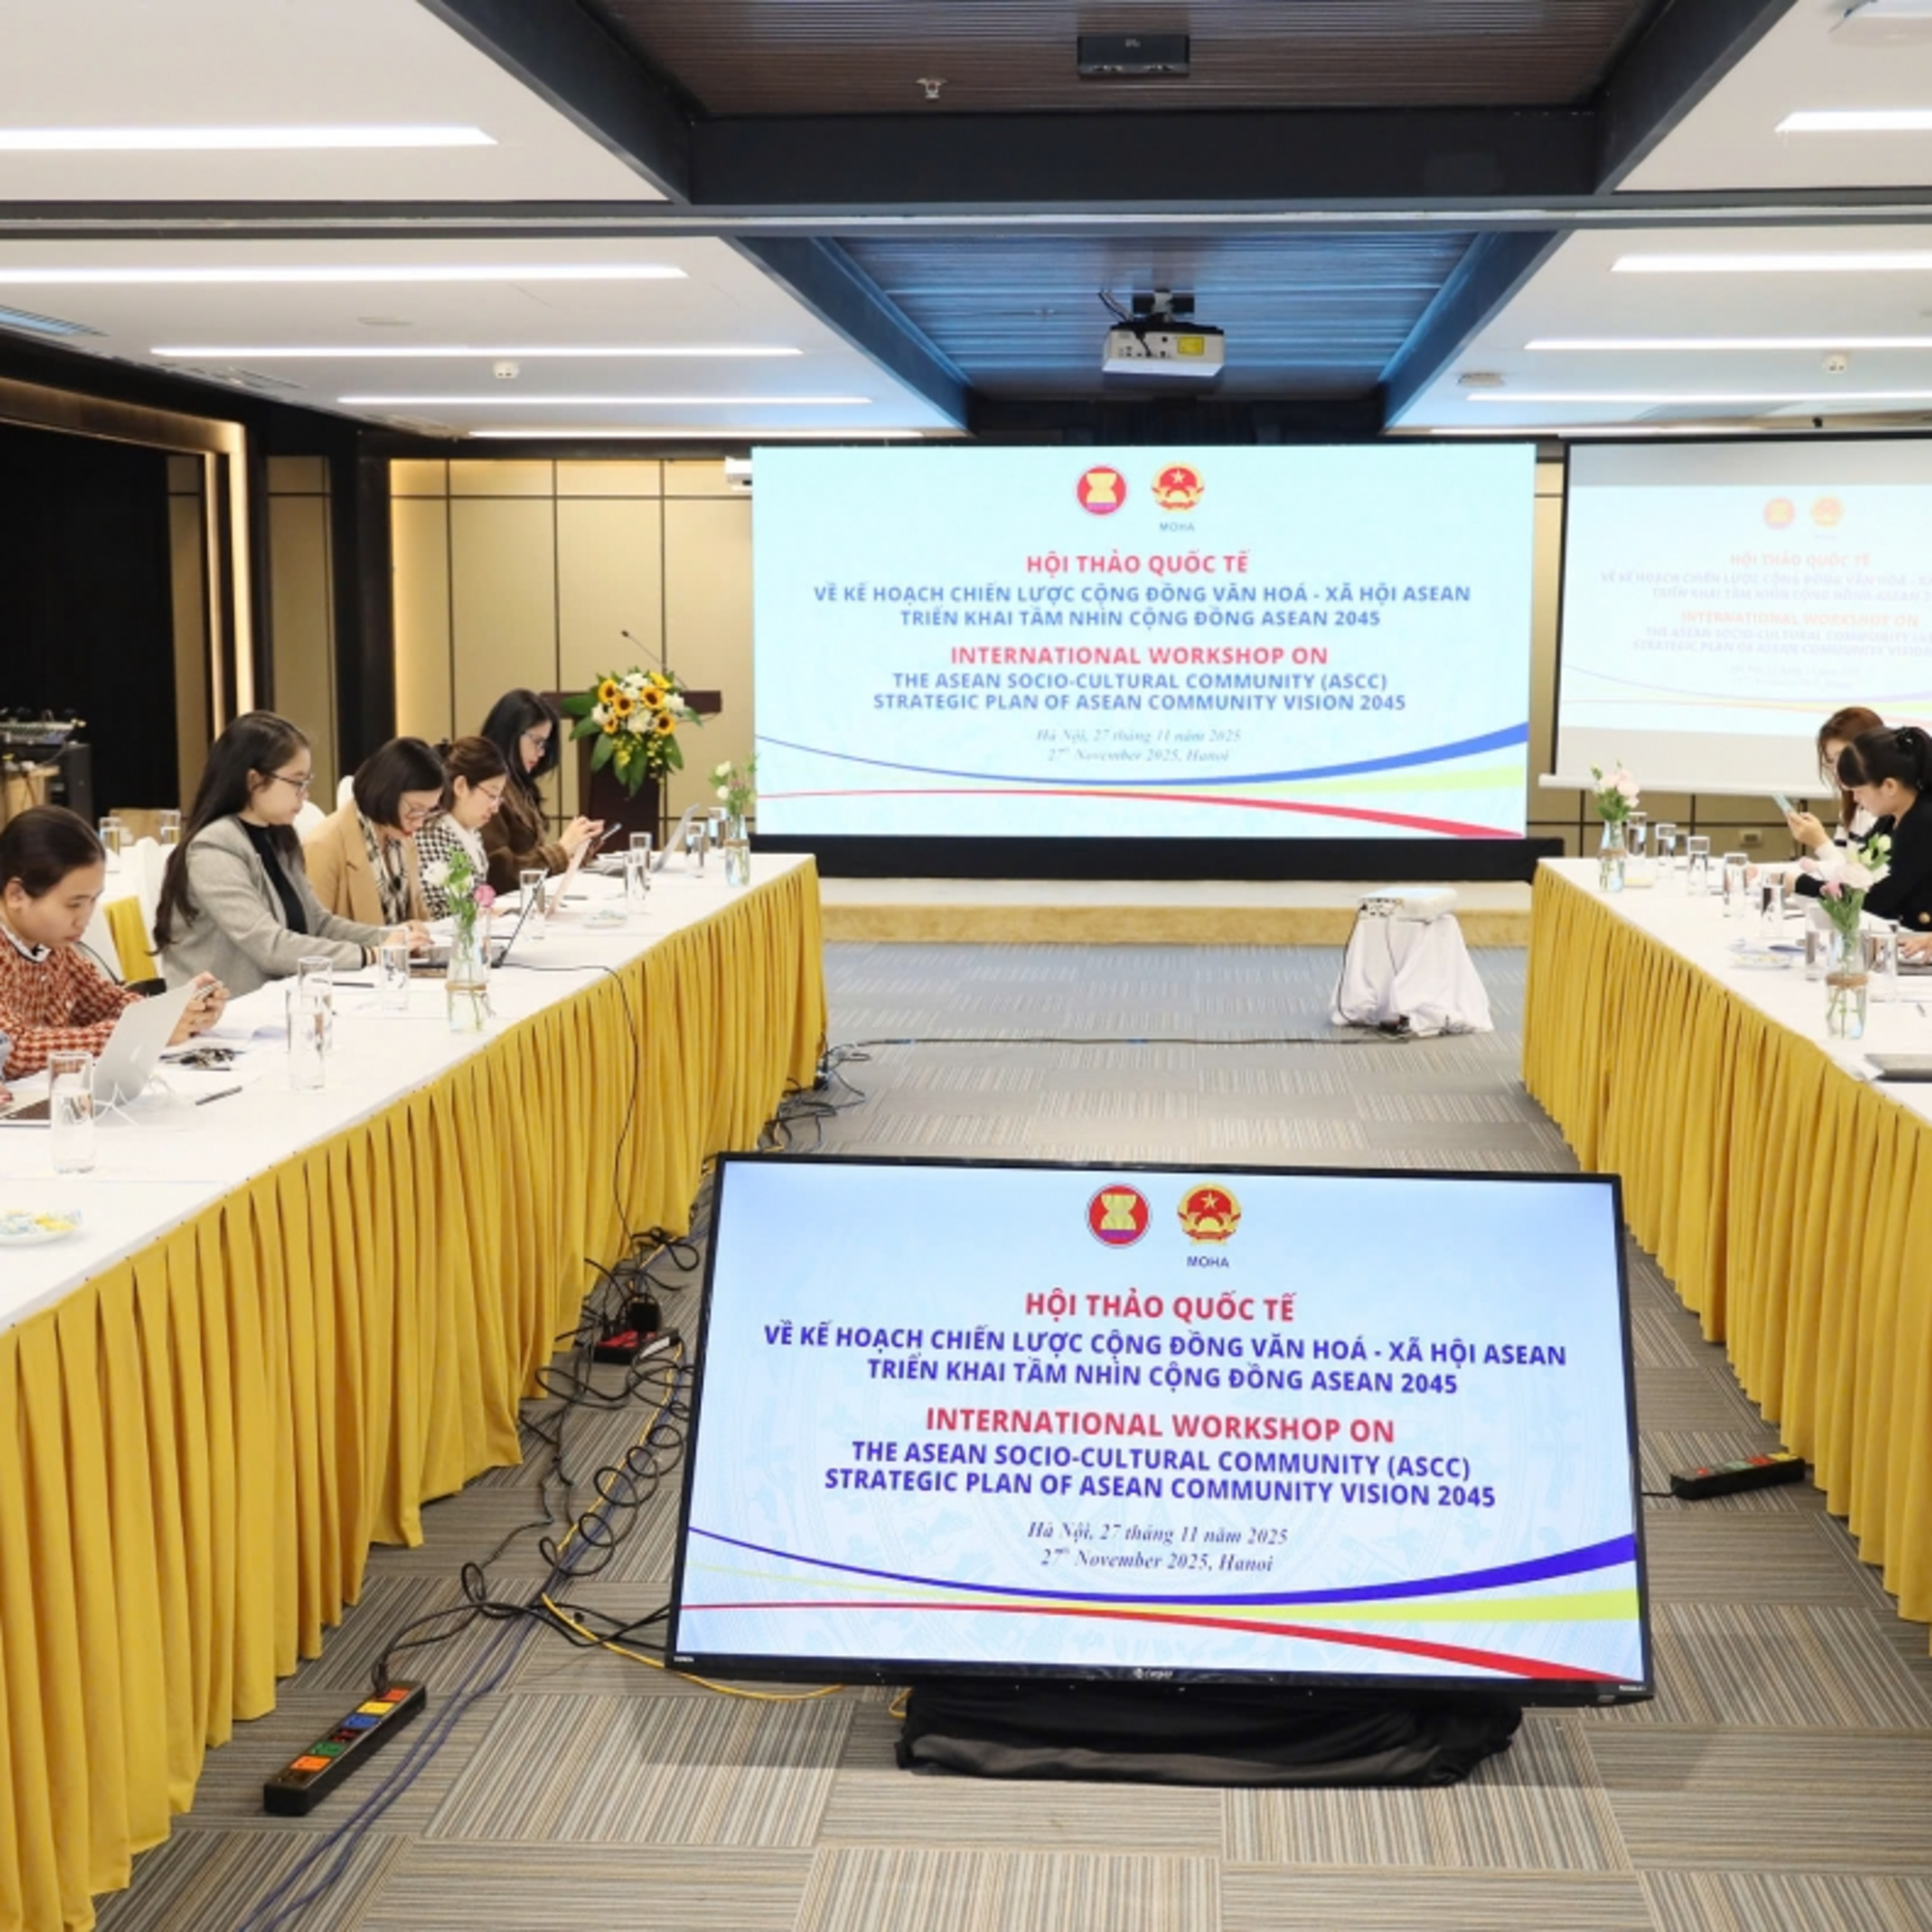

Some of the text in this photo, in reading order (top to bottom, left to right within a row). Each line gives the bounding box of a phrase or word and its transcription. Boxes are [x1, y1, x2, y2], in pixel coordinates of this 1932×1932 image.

[1159, 522, 1195, 532] MOHA
[1027, 549, 1249, 578] HỘI THẢO QUỐC TẾ
[813, 582, 837, 601] VỀ
[844, 582, 866, 602] KẾ
[873, 586, 943, 605] HOẠCH
[950, 583, 1011, 602] CHIẾN
[1018, 585, 1075, 605] LƯỢC
[1081, 583, 1139, 606] CỘNG
[1145, 582, 1206, 603] ĐỒNG
[1213, 582, 1256, 601] VĂN
[1263, 583, 1307, 602] HOÁ
[1325, 582, 1354, 601] XÃ
[1359, 582, 1397, 606] HỘI
[1402, 585, 1470, 602] ASEAN
[900, 607, 1381, 630] TRIỂN KHAI TẦM NHÌN CỘNG ĐỒNG ASEAN 2045
[951, 647, 1329, 665] INTERNATIONAL WORKSHOP ON
[893, 672, 1387, 692] THE ASEAN SOCIO-CULTURAL COMMUNITY (ASCC)
[874, 694, 1406, 710] STRATEGIC PLAN OF ASEAN COMMUNITY VISION 2045
[1187, 1256, 1229, 1268] MOHA
[1025, 1287, 1296, 1324] HỘI THẢO QUỐC TẾ
[764, 1319, 793, 1345] VỀ
[800, 1320, 831, 1347] KẾ
[835, 1327, 923, 1356] HOẠCH
[930, 1325, 1005, 1351] CHIẾN
[1012, 1331, 1083, 1359] LƯỢC
[1090, 1328, 1162, 1361] CỘNG
[1170, 1330, 1244, 1358] ĐỒNG
[1251, 1333, 1305, 1358] VĂN
[1313, 1335, 1368, 1361] HOÁ
[1388, 1336, 1423, 1362] XÃ
[1430, 1337, 1476, 1369] HỘI
[1482, 1343, 1566, 1367] ASEAN
[867, 1354, 1458, 1395] TRIỂN KHAI TẦM NHÌN CỘNG ĐỒNG ASEAN 2045
[926, 1407, 1394, 1443] INTERNATIONAL WORKSHOP ON
[852, 1441, 1471, 1482] THE ASEAN SOCIO-CULTURAL COMMUNITY (ASCC)
[825, 1468, 1495, 1508] STRATEGIC PLAN OF ASEAN COMMUNITY VISION 2045
[1028, 1522, 1287, 1545] Hà Nội, 27 tháng 11 năm 2025
[1079, 1550, 1162, 1568] November
[1168, 1553, 1212, 1571] 2025,
[1219, 1554, 1273, 1571] Hanoi
